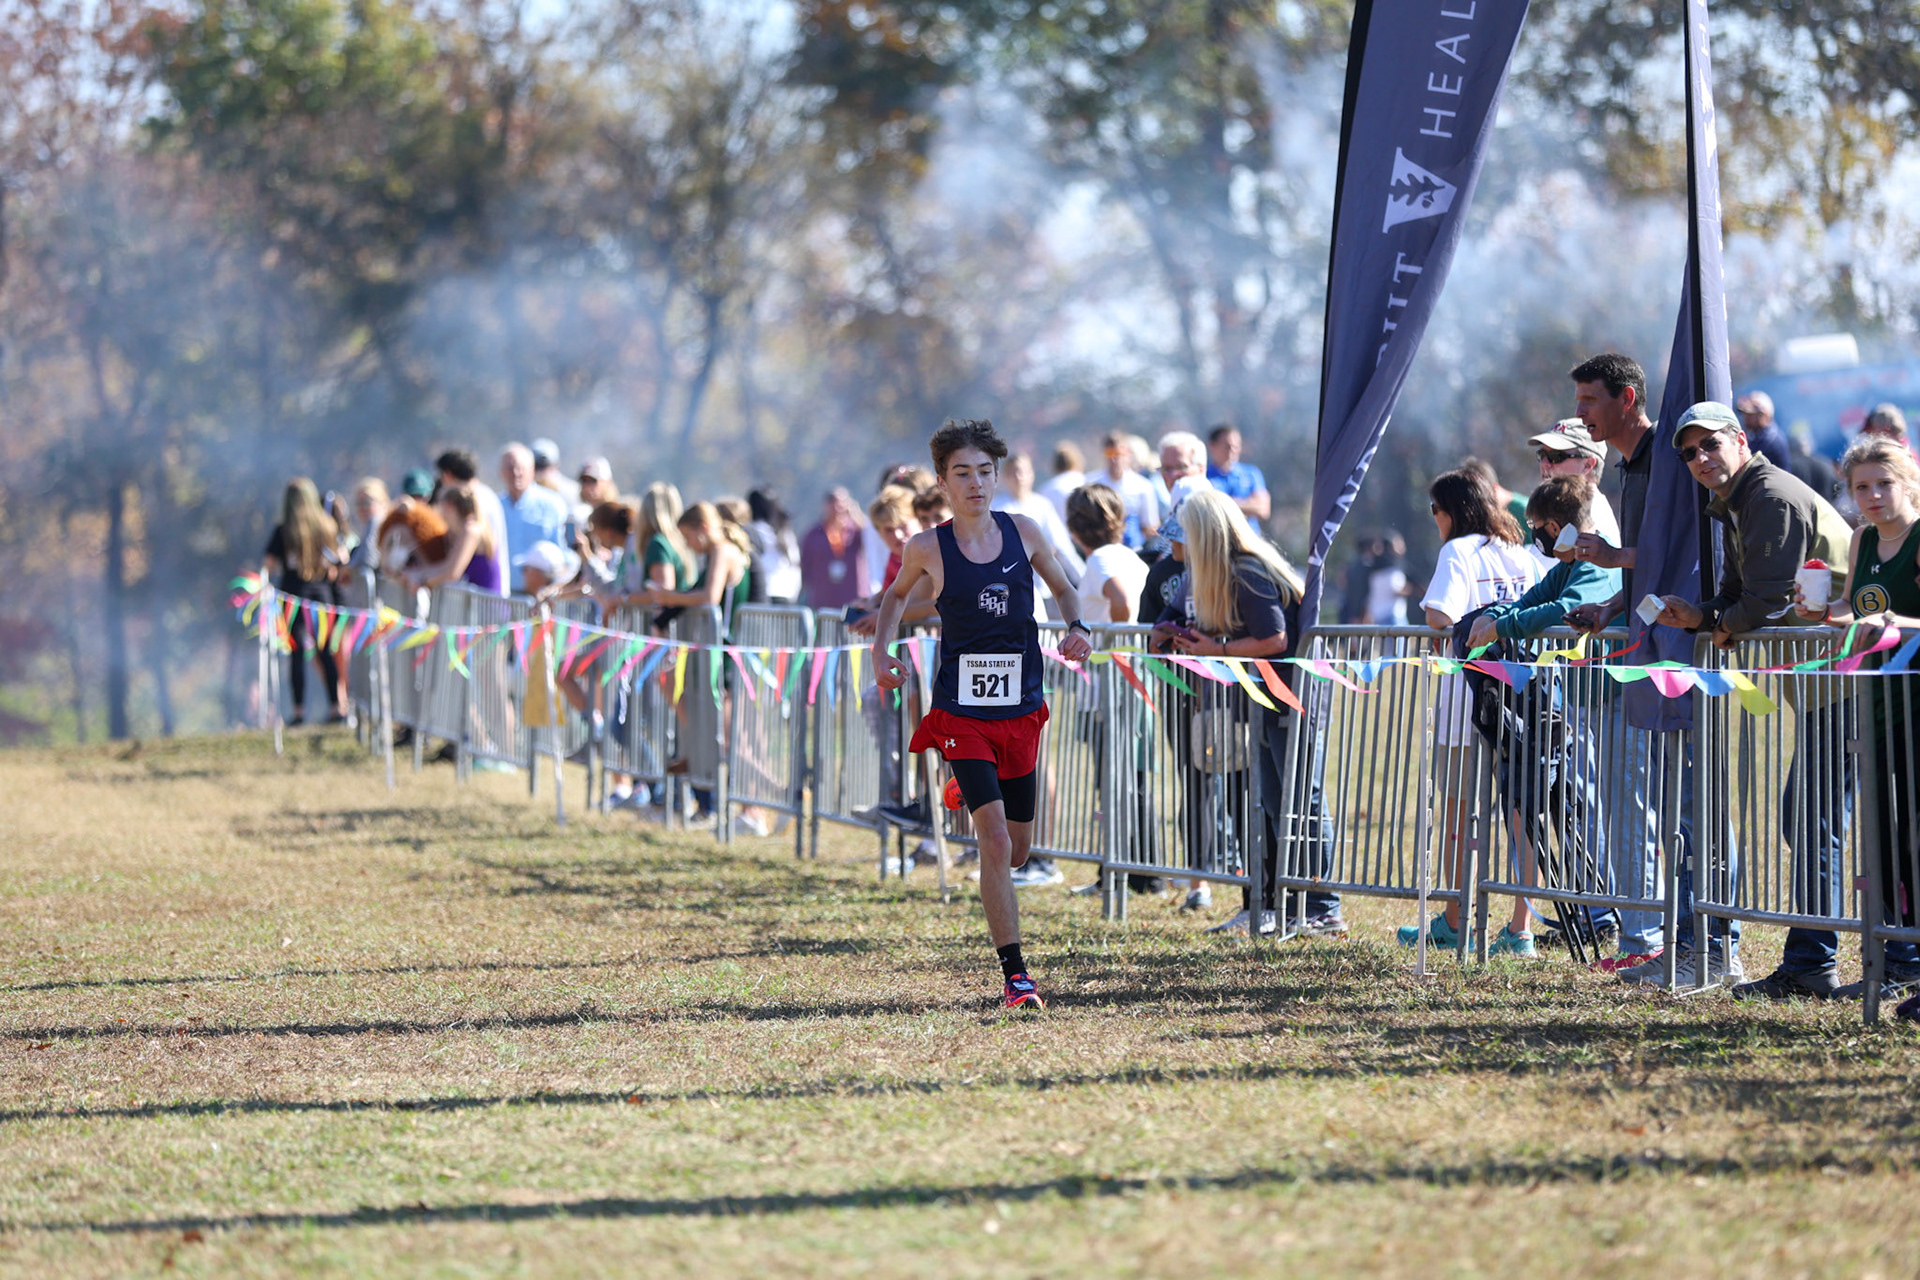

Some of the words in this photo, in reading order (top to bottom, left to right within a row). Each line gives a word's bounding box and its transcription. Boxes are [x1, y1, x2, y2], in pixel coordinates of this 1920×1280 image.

[979, 591, 1008, 617] SBA
[1861, 591, 1881, 613] B
[966, 660, 988, 668] TSSAA
[988, 660, 1007, 668] STATE
[971, 673, 1010, 698] 521
